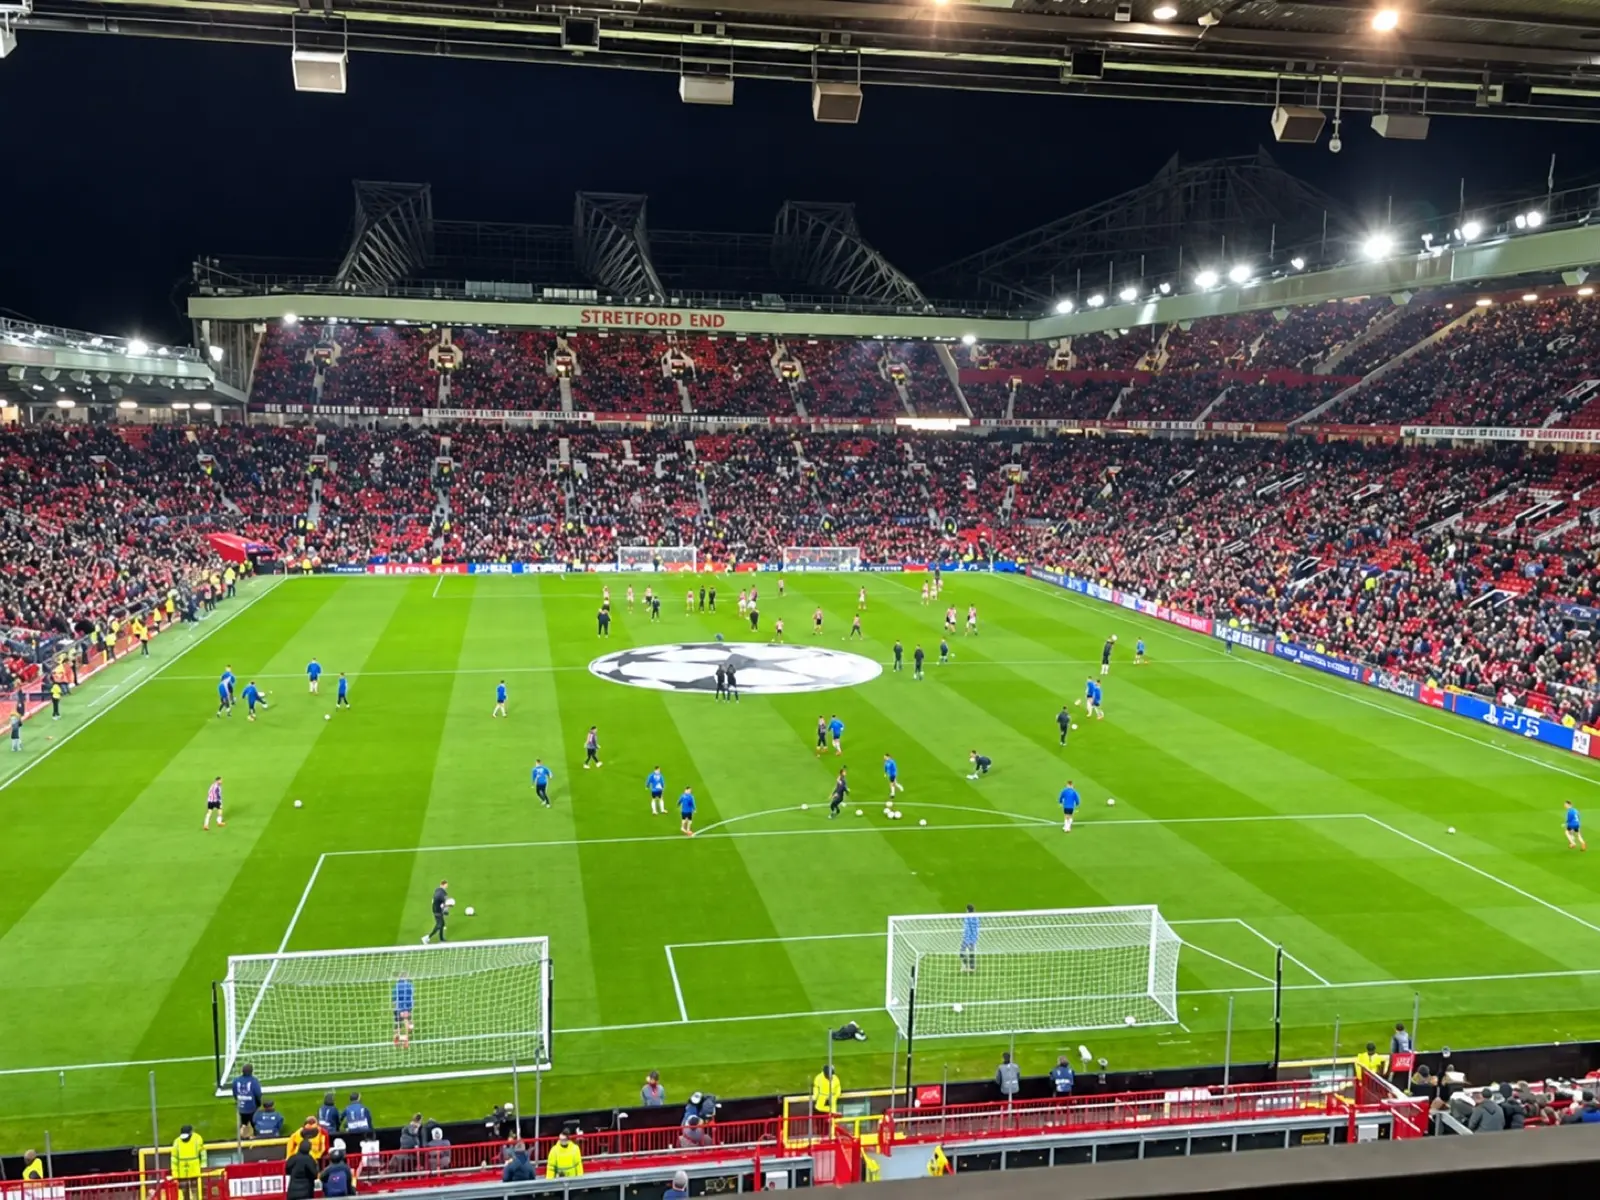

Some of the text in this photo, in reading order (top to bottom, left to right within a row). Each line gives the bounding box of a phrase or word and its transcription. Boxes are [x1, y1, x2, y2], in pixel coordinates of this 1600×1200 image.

[580, 309, 725, 328] STRETFORD END
[1502, 710, 1540, 736] PS5
